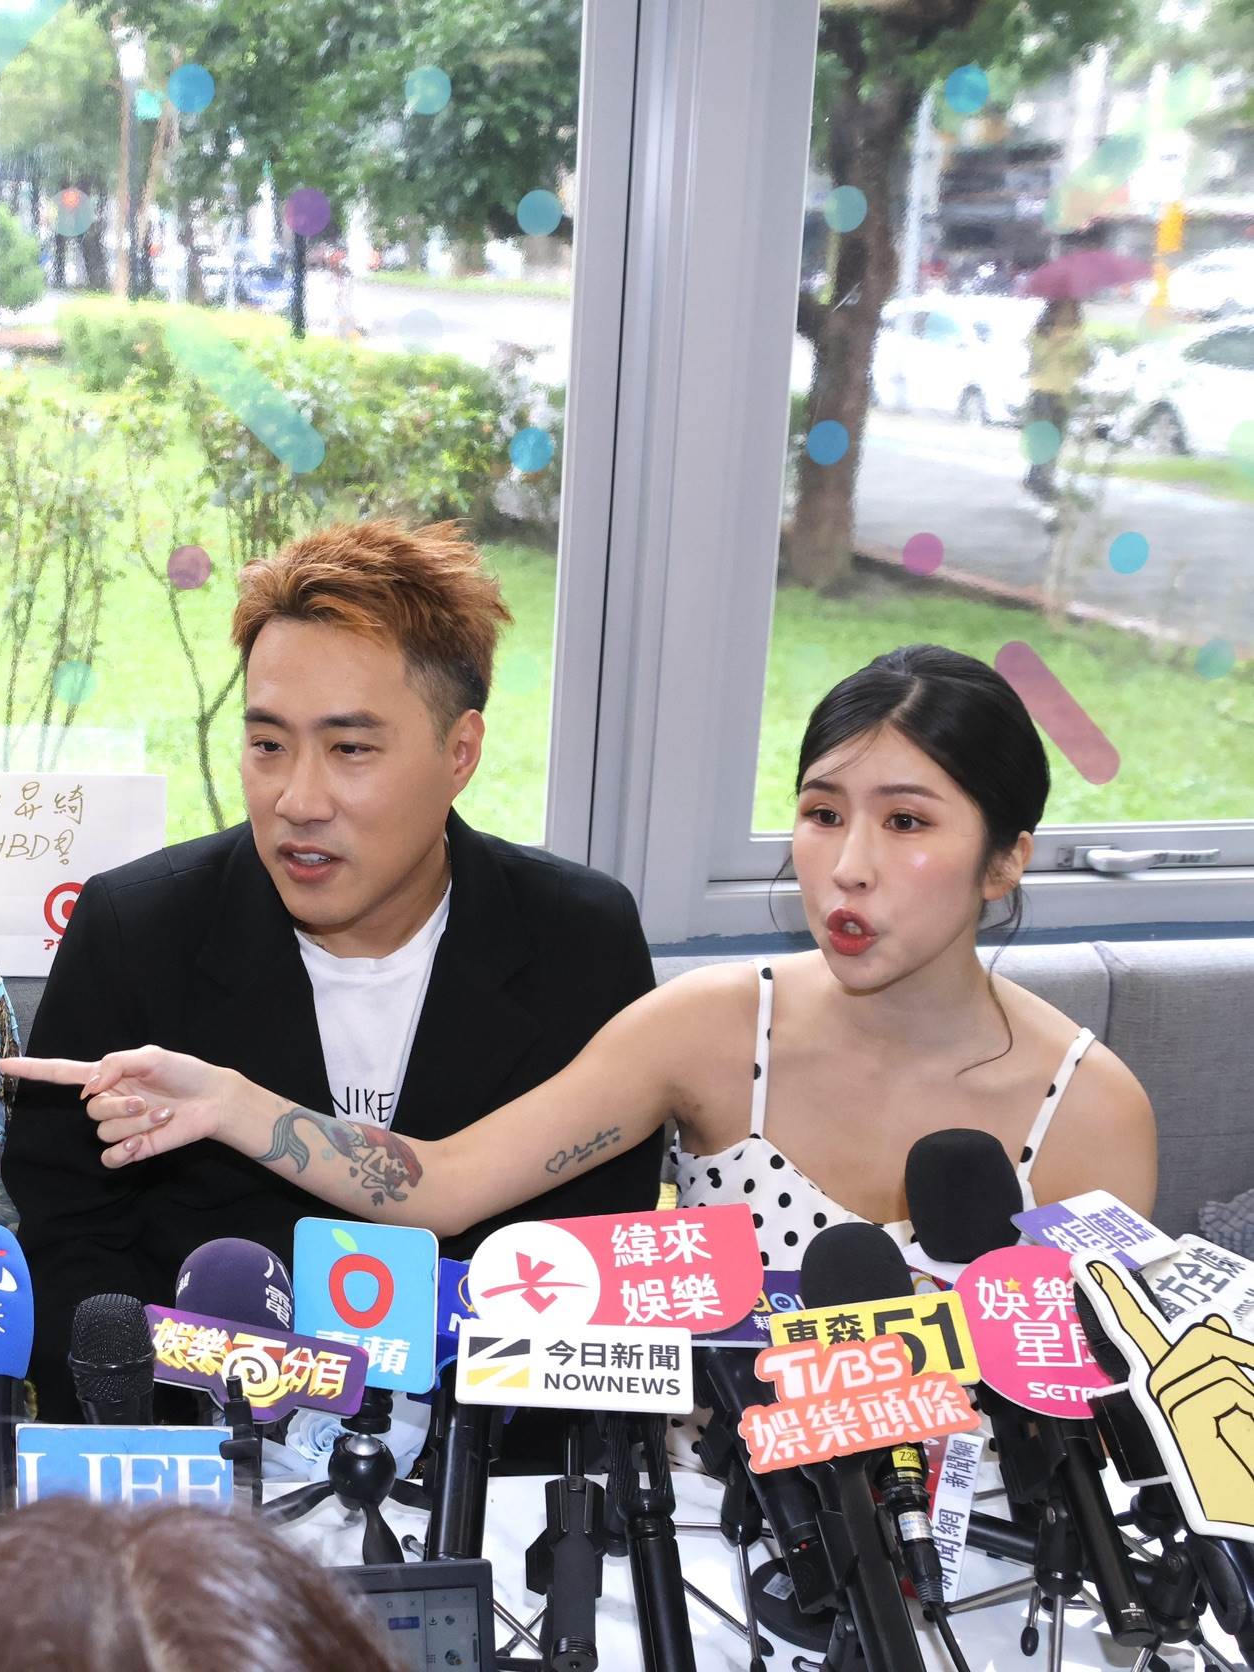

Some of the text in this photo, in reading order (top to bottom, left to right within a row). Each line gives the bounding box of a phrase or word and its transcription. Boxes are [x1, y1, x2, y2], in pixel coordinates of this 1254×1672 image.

[331, 1086, 395, 1123] NIKE
[609, 1219, 713, 1269] 緯來
[620, 1273, 725, 1325] 娛樂
[974, 1276, 1077, 1321] 娛樂
[544, 1339, 681, 1372] 今日新聞
[763, 1341, 904, 1400] TVBS
[543, 1373, 681, 1397] NOWNEWS
[747, 1378, 971, 1466] 娛樂頭條
[940, 1439, 979, 1490] 新聞網
